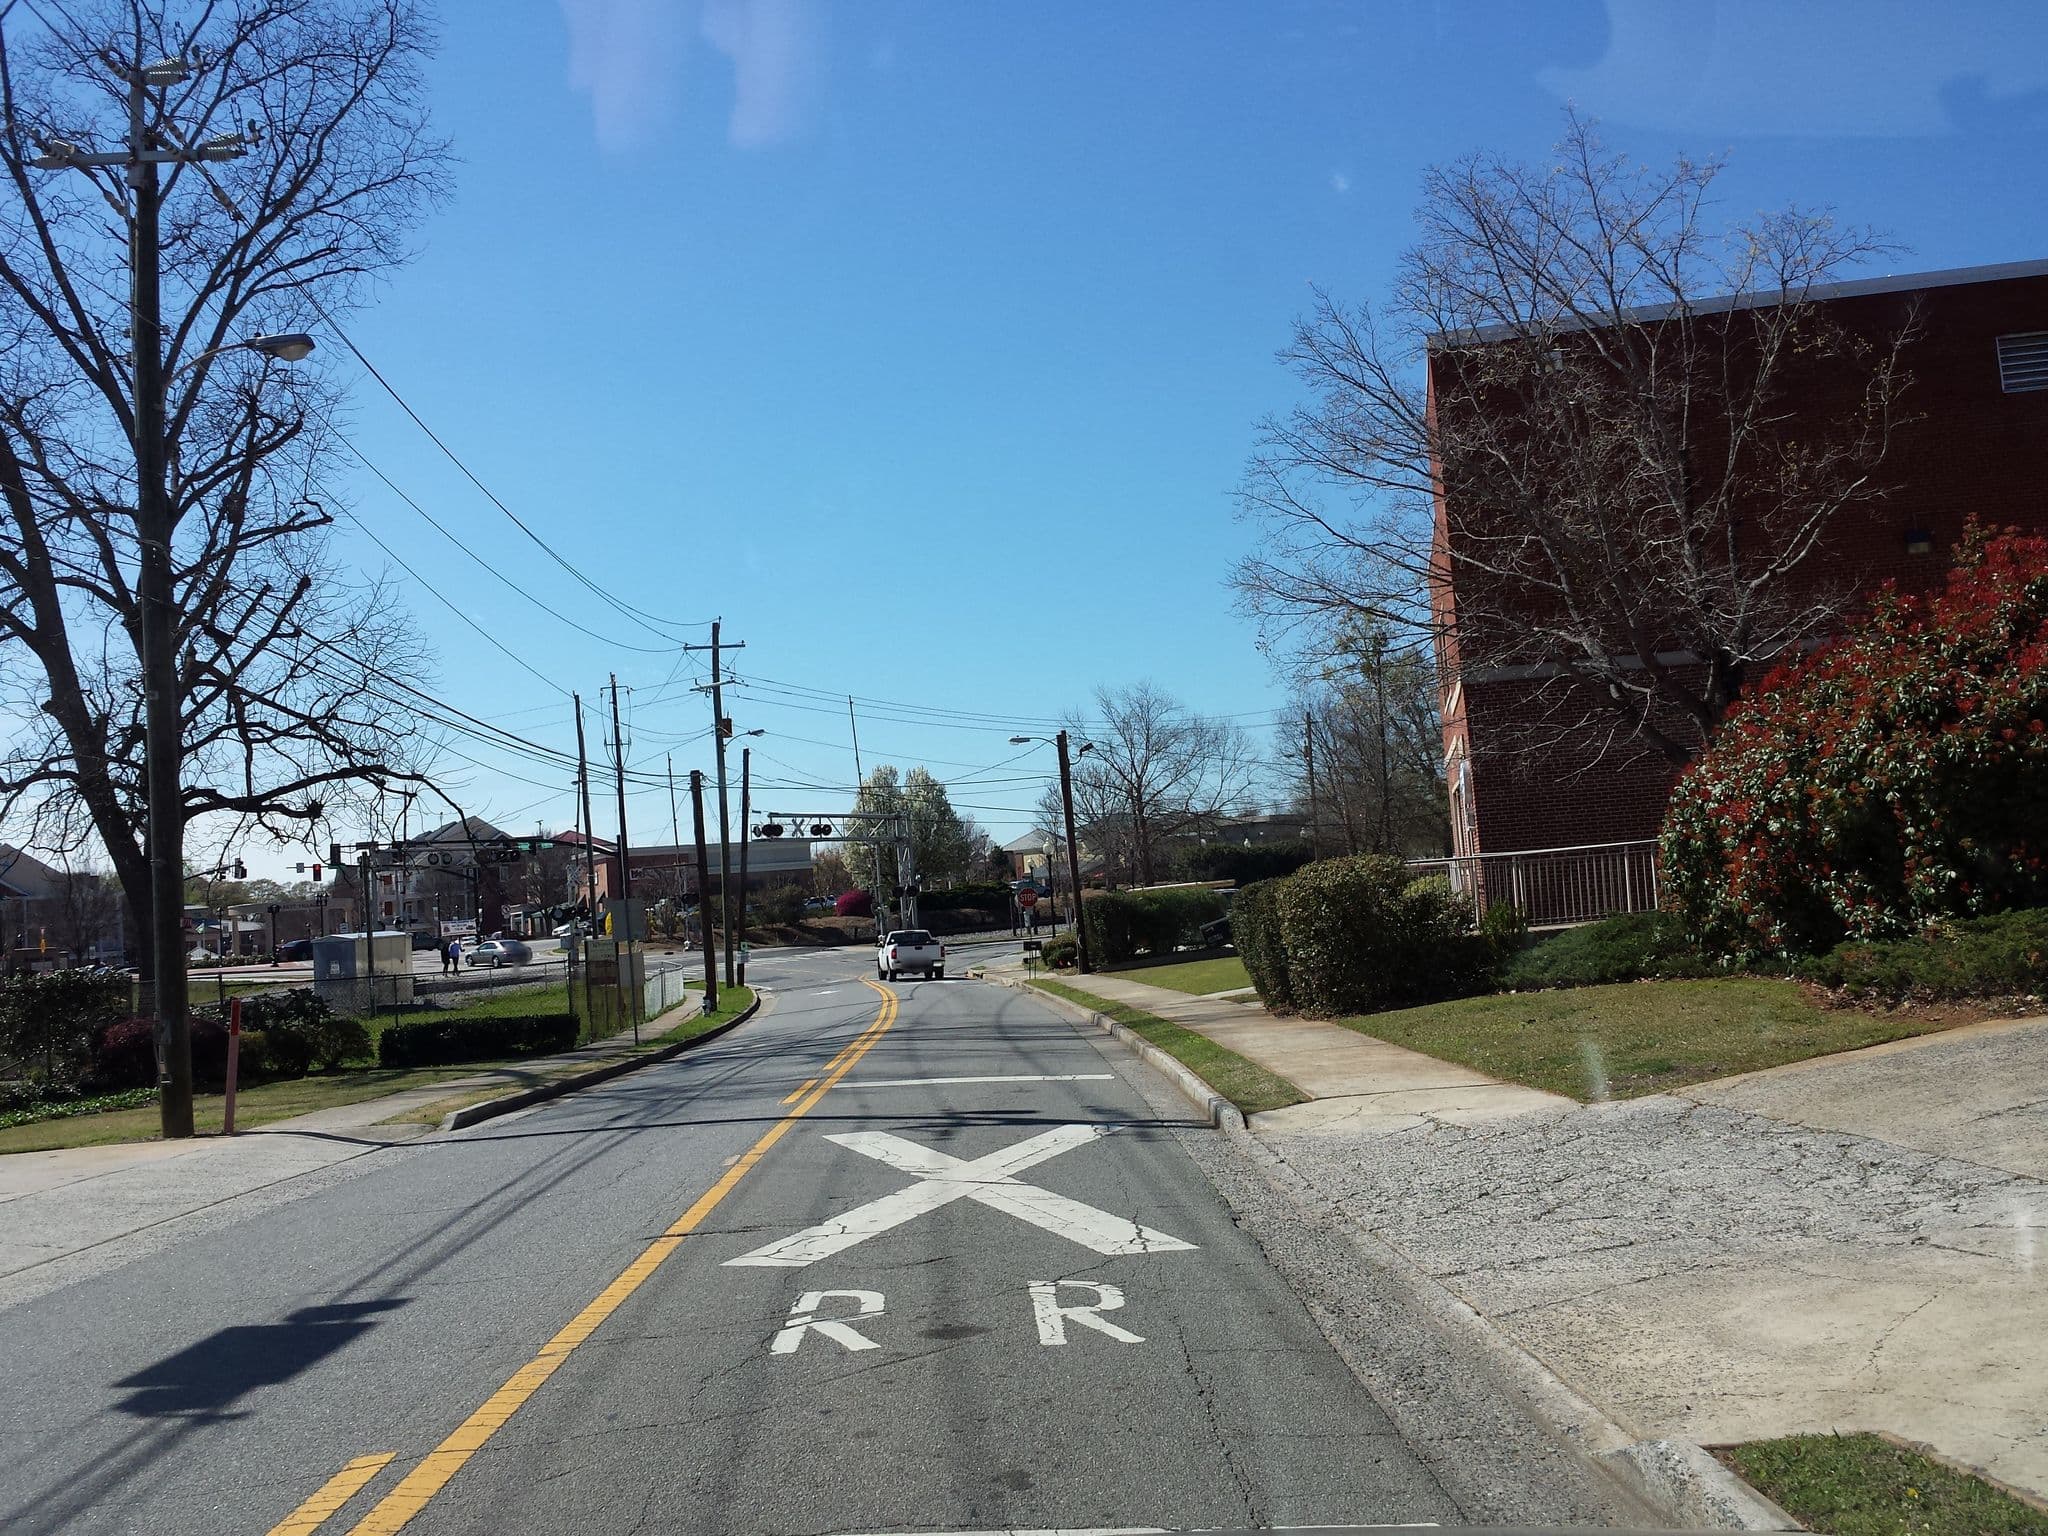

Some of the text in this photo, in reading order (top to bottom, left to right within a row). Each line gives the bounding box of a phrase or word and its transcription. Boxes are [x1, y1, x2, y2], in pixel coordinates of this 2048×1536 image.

[1019, 893, 1037, 902] STOP
[720, 1124, 1201, 1267] X
[769, 1280, 1146, 1356] R R
